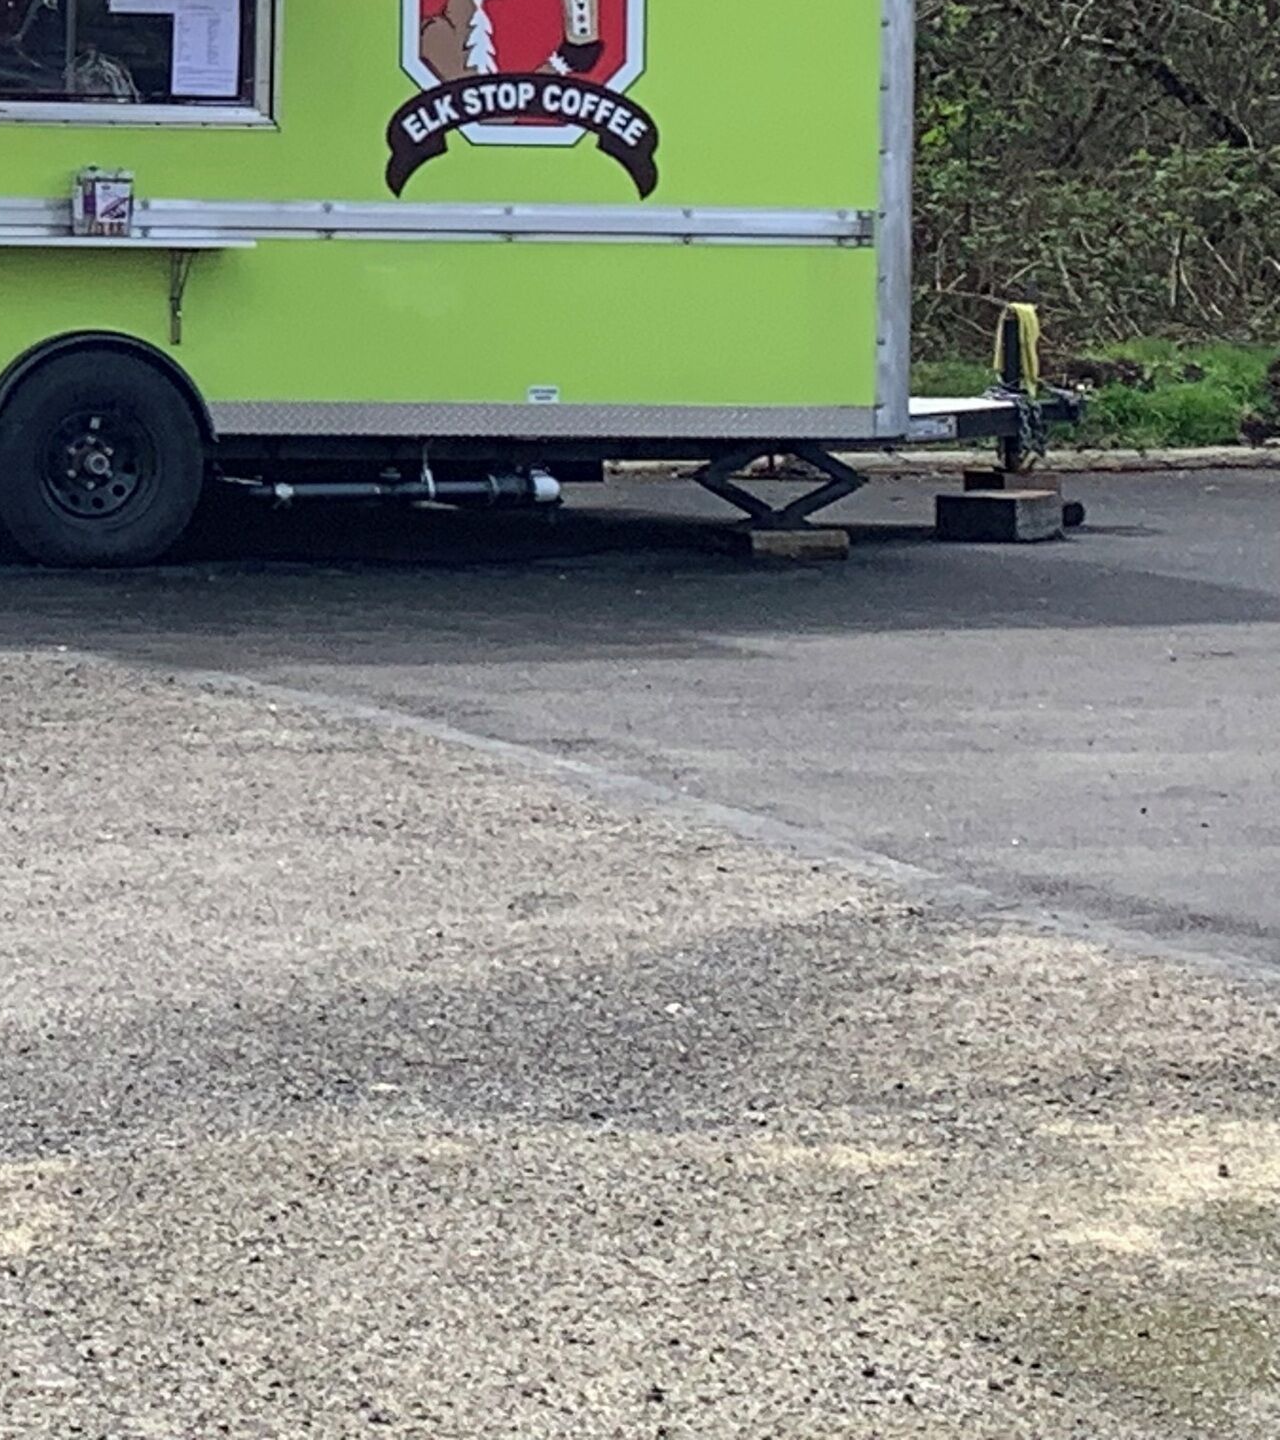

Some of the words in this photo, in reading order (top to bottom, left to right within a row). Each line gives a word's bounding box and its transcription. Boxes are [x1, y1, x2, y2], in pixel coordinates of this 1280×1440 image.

[401, 93, 460, 144] ELK
[462, 82, 536, 114] STOP
[542, 84, 649, 147] COFFEE
